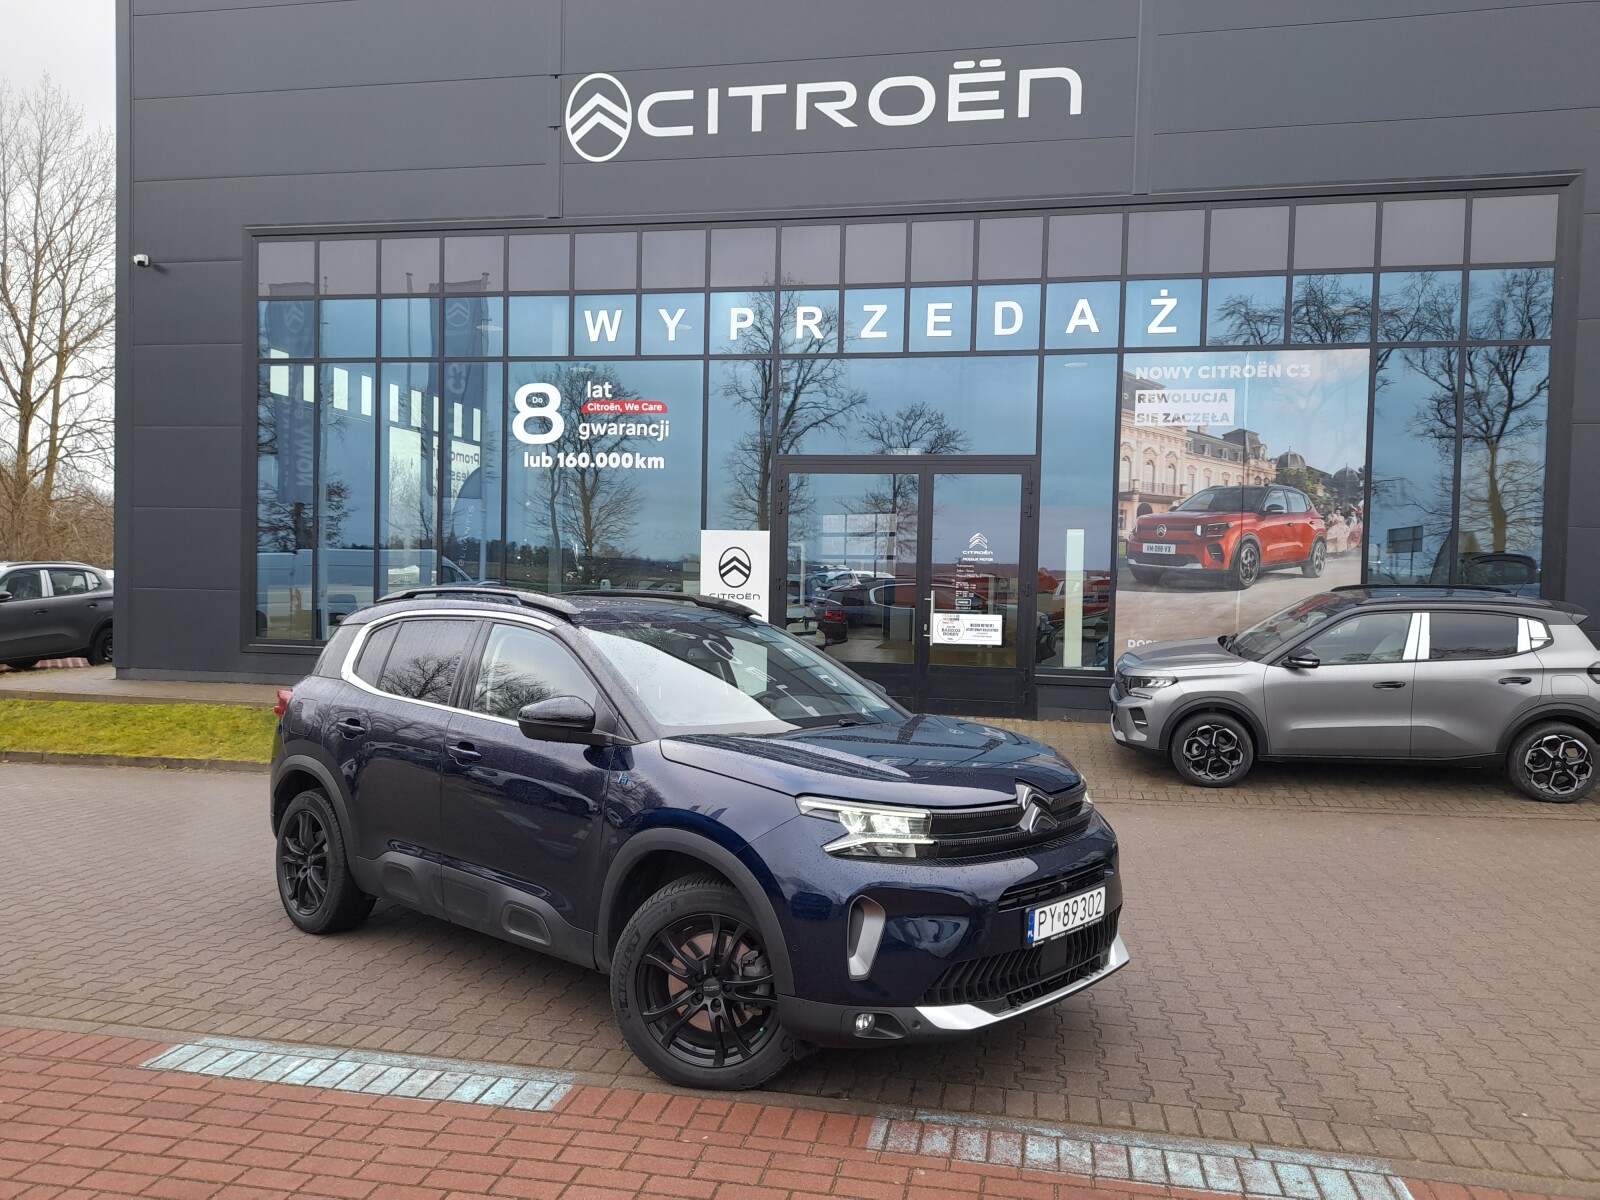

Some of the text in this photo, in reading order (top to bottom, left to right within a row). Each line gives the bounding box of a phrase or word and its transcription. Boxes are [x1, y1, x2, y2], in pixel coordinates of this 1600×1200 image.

[1136, 361, 1311, 380] NOWY CITROËN C3
[587, 381, 612, 398] lat
[532, 396, 543, 404] Do
[1137, 392, 1228, 404] REWOLUCJA
[512, 383, 565, 445] 8
[587, 402, 663, 412] Citroën, We Care
[1136, 412, 1230, 426] SIĘ ZACZĘŁA
[579, 420, 670, 441] gwarancji
[523, 452, 553, 468] lub
[1037, 891, 1102, 937] PY 89302
